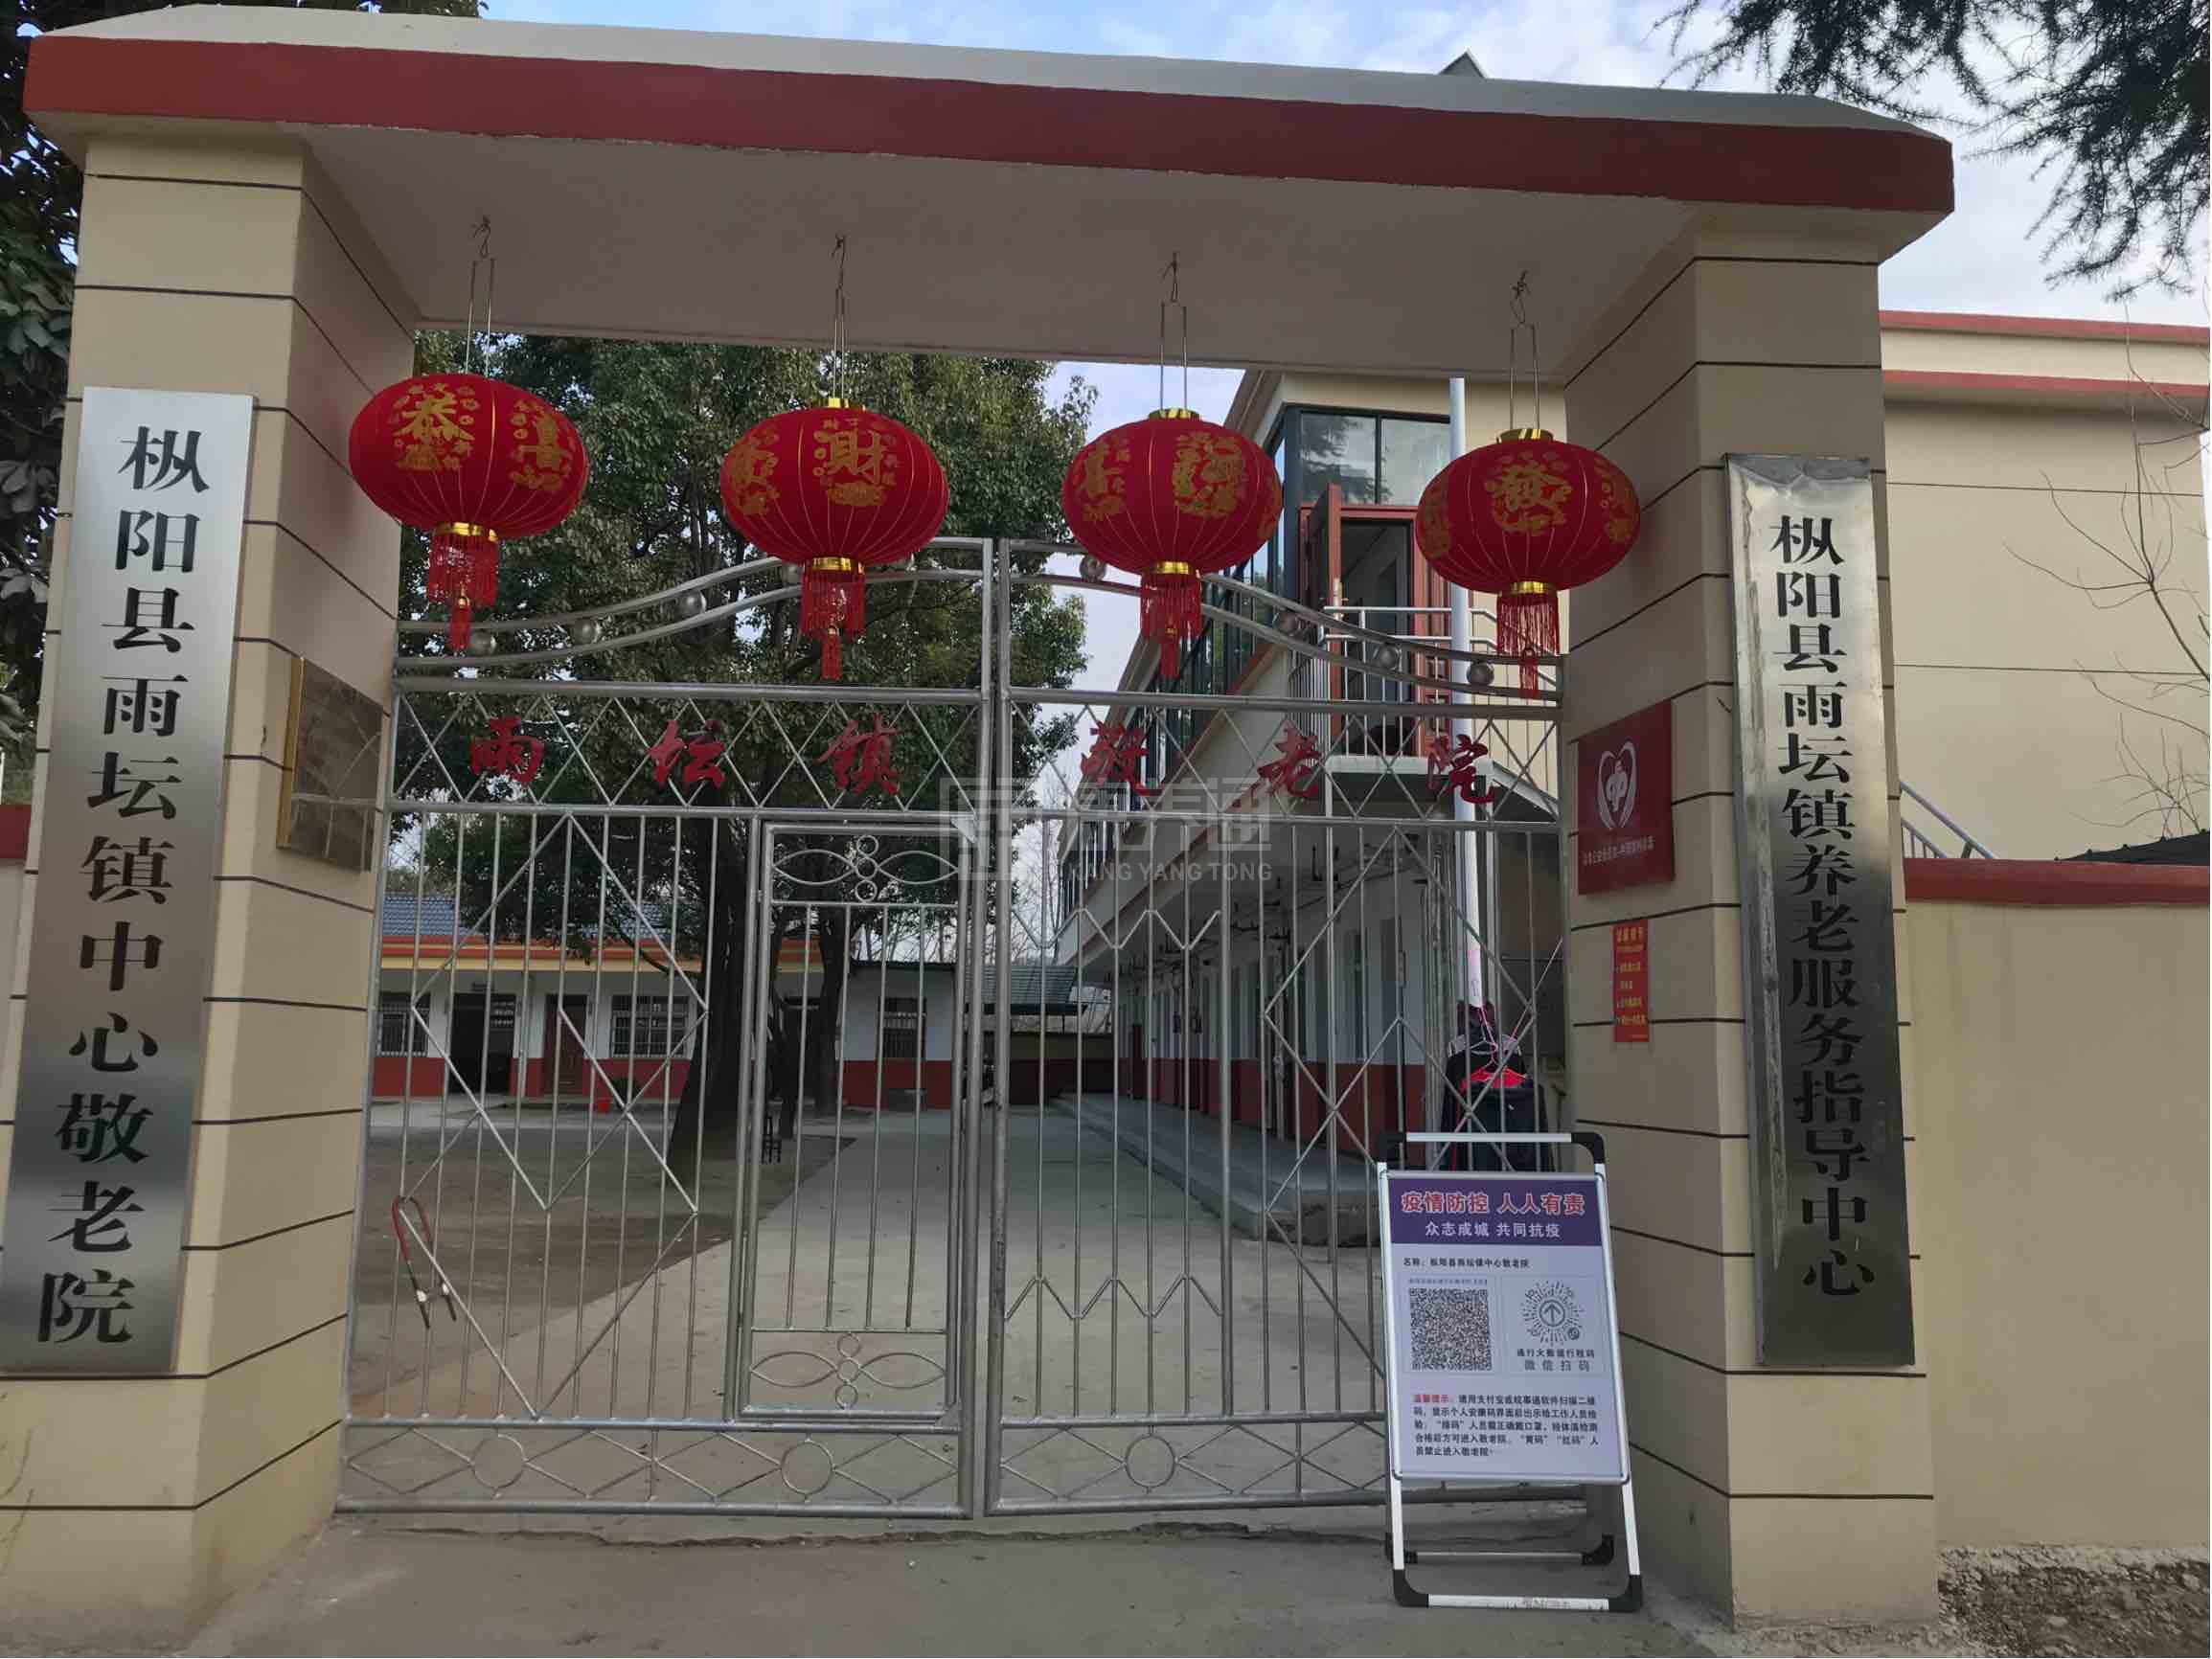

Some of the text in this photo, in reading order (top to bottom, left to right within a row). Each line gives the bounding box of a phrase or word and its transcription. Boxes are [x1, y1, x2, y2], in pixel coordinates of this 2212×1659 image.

[38, 426, 210, 1343] 枞阳县雨坛镇中心敬老院
[1769, 514, 1875, 1296] 枞阳县雨坛镇养老服务指导中心
[1401, 1192, 1586, 1216] 疫情防控 人人有责
[1425, 1221, 1561, 1239] 众志成城 共同抗疫
[1524, 1360, 1590, 1372] 微信扫码
